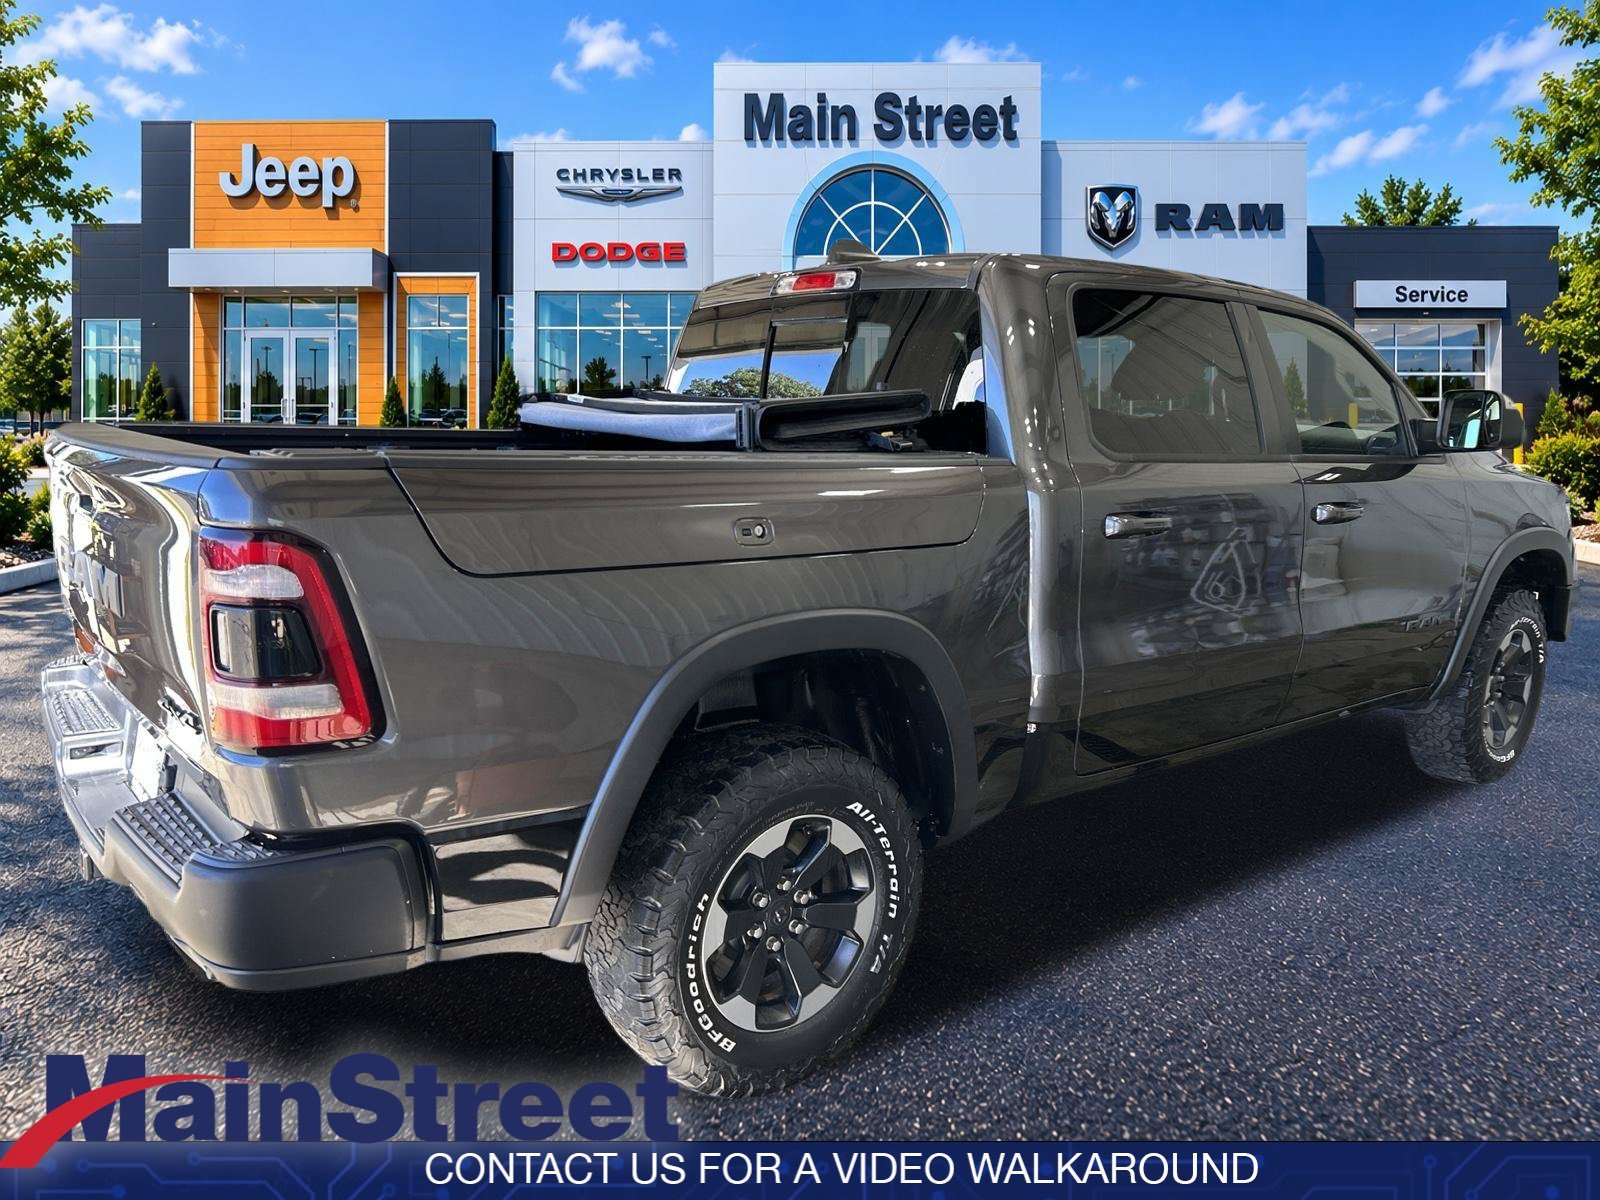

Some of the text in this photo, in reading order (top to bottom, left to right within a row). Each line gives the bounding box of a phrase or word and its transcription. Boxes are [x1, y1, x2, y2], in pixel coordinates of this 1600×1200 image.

[744, 91, 1018, 142] Main Street
[218, 143, 355, 208] Jeep
[556, 168, 683, 181] CHRYSLER
[1155, 203, 1284, 231] RAM
[551, 242, 687, 262] DODGE
[1395, 285, 1469, 303] Service
[846, 801, 900, 974] All-Terrain T/A
[685, 893, 737, 1053] BFGoodrich
